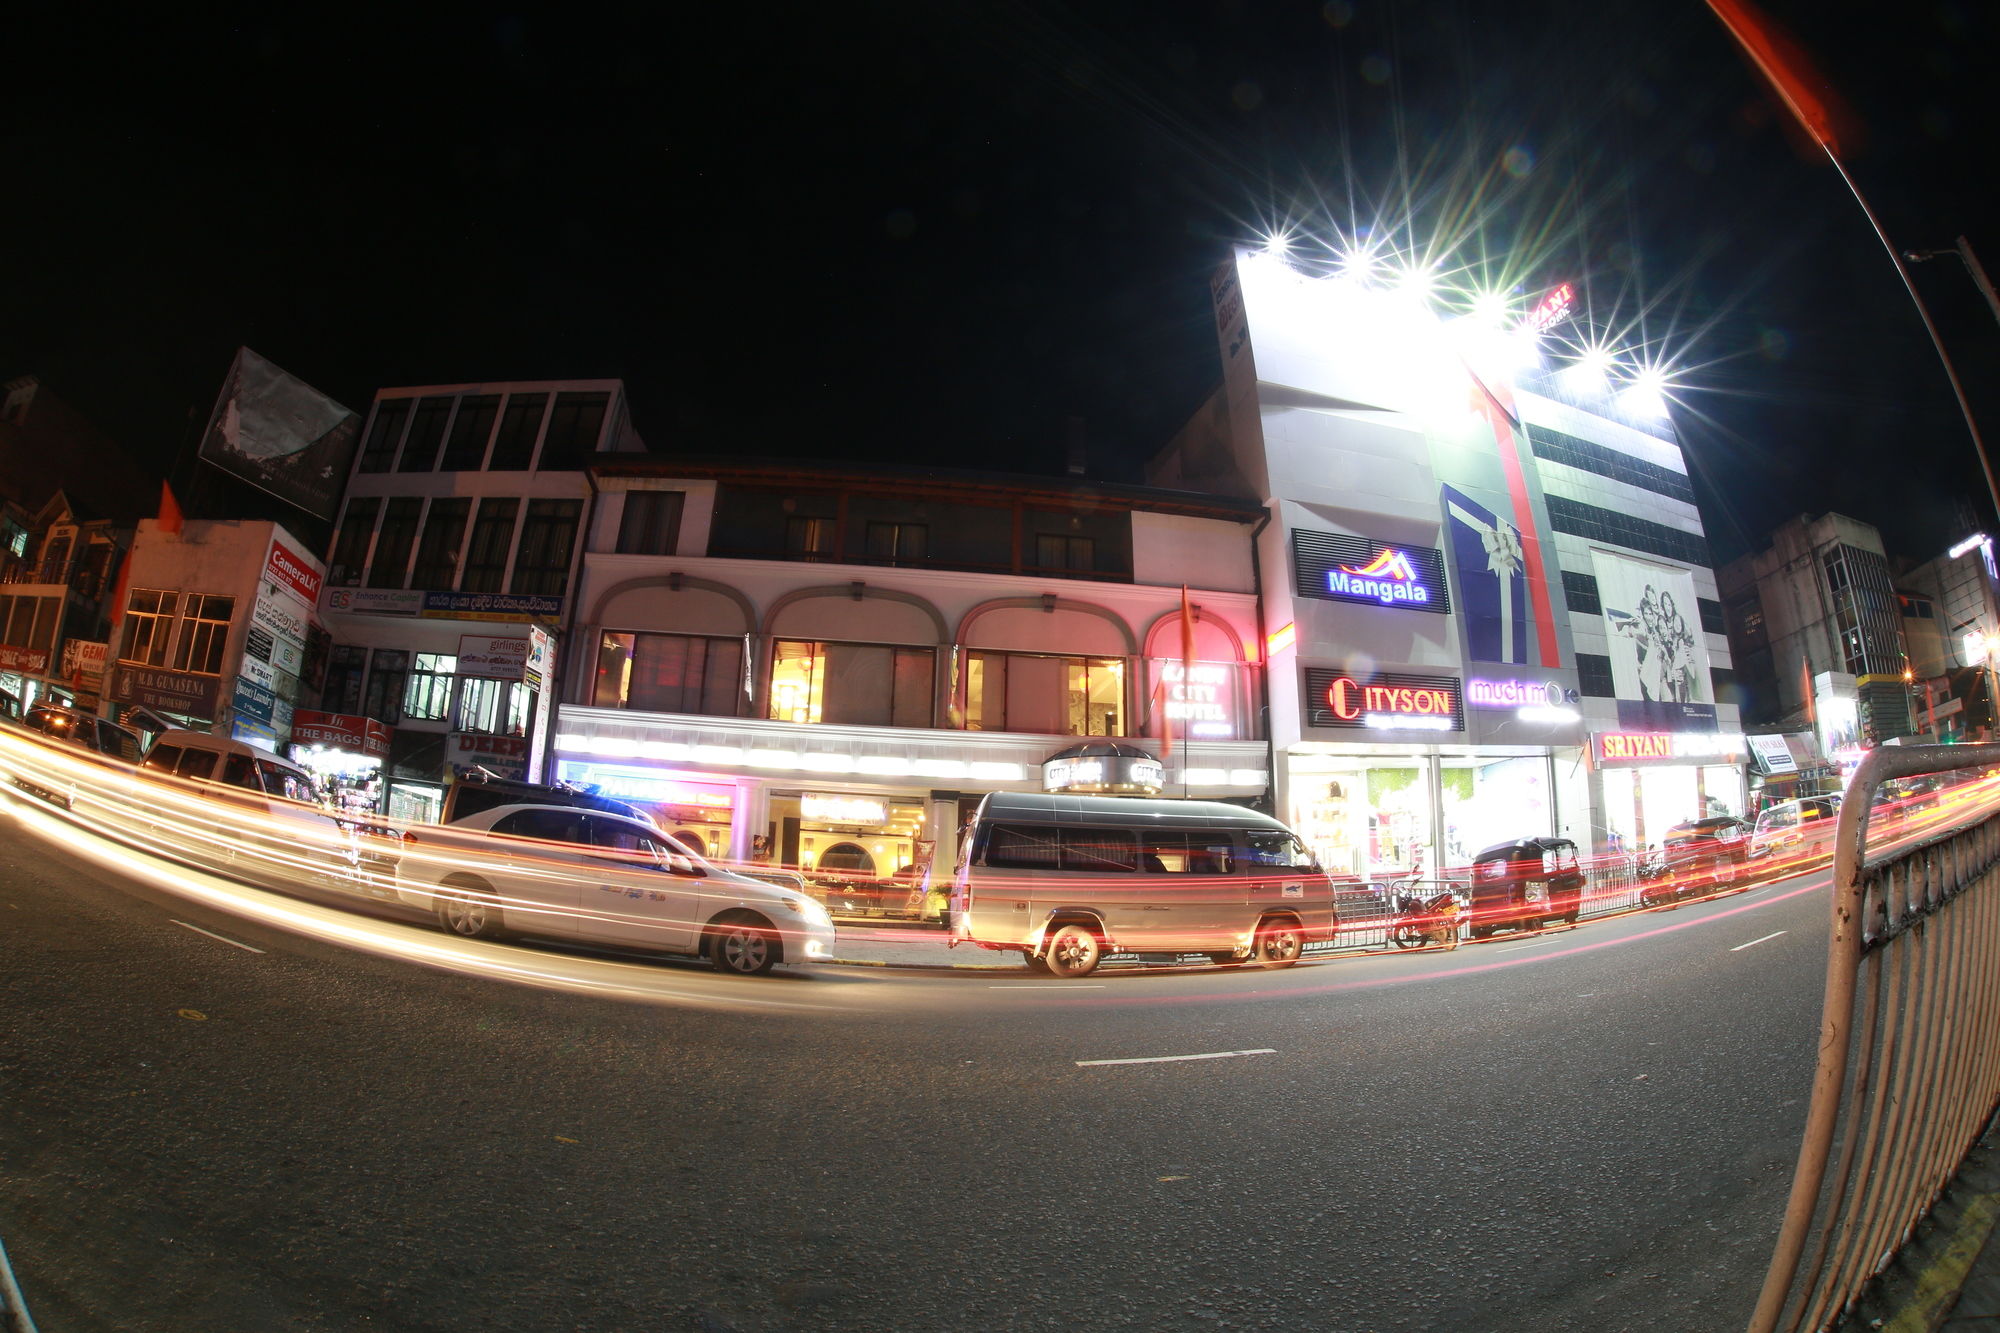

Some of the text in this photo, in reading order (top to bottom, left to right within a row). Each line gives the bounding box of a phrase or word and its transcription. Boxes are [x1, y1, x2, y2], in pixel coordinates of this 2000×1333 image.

[272, 550, 318, 593] CameraLK
[1328, 571, 1427, 603] Mangala
[489, 639, 526, 652] girlings
[156, 674, 204, 696] GUNASENA
[1470, 680, 1527, 703] much
[294, 727, 362, 745] THE BAGS
[1603, 735, 1672, 758] SRIYANI
